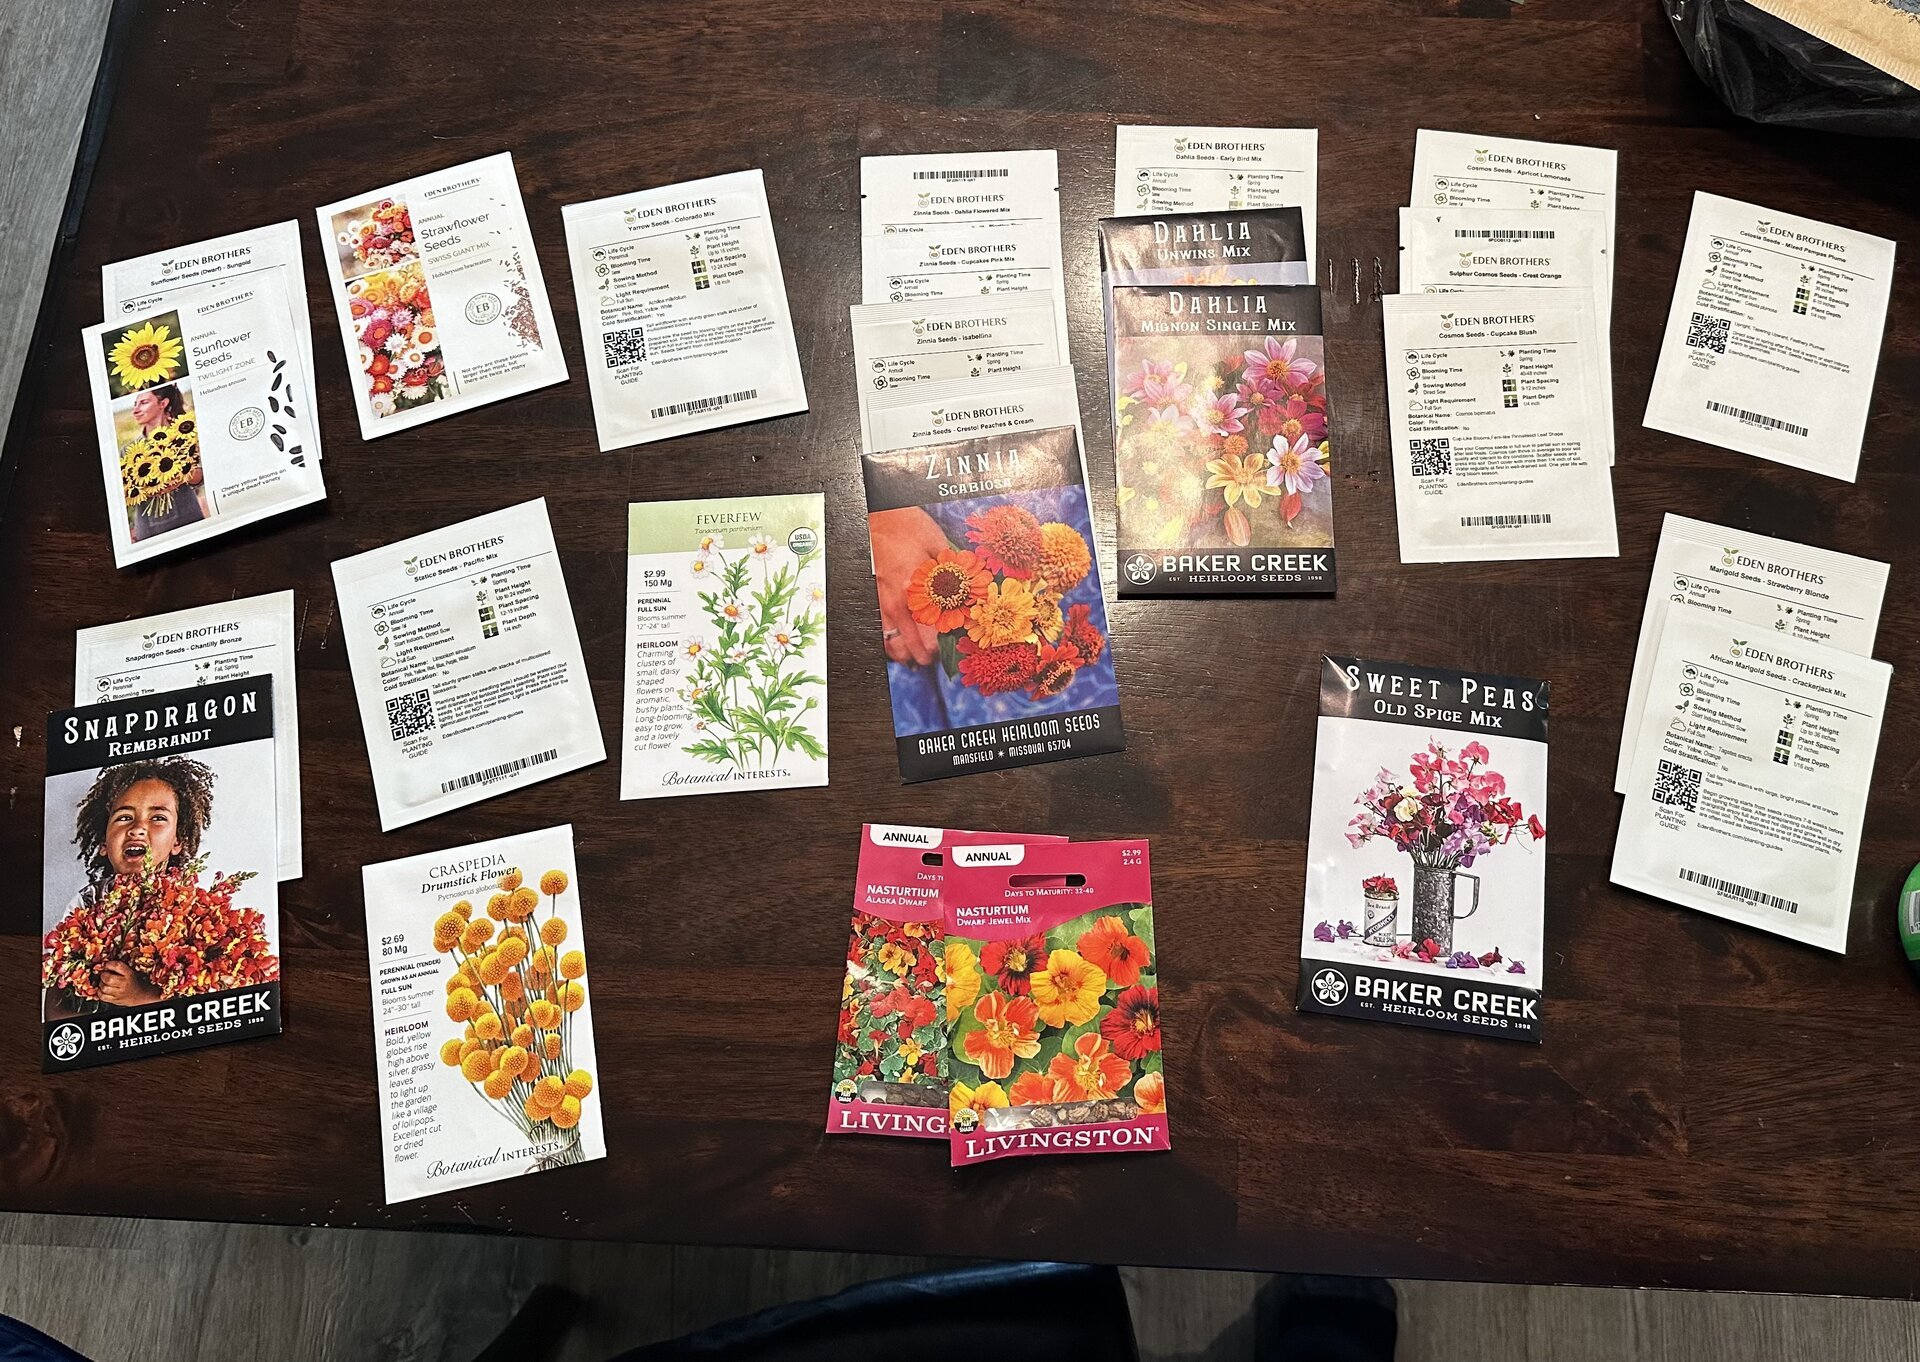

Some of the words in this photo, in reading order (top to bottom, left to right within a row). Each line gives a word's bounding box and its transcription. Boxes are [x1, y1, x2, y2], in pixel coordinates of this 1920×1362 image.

[1187, 142, 1213, 150] EDEN
[1214, 142, 1265, 152] BROTHERS
[1488, 154, 1514, 164] EDEN
[1515, 157, 1567, 171] BROTHERS
[637, 207, 663, 219] EDEN
[664, 197, 717, 214] BROTHERS
[930, 196, 955, 204] EDEN
[956, 194, 1004, 204] BROTHERS
[418, 213, 444, 225] ANNUAL
[420, 213, 490, 240] Strawflower
[1152, 221, 1251, 245] DAHLIA
[1769, 226, 1795, 239] EDEN
[1795, 233, 1845, 253] BROTHERS
[423, 235, 462, 253] Seeds
[427, 252, 453, 265] SWISS
[452, 244, 475, 258] GIANT
[476, 241, 491, 250] MIX
[941, 247, 966, 256] EDEN
[967, 243, 1017, 254] BROTHERS
[1156, 245, 1216, 262] UNWINS
[1221, 244, 1252, 259] MIX
[174, 259, 200, 271] EDEN
[201, 246, 251, 265] BROTHERS
[1472, 256, 1498, 265] EDEN
[1499, 256, 1551, 267] BROTHERS
[150, 275, 181, 287] Sunflower
[181, 271, 200, 280] Seeds
[200, 265, 222, 276] (Dwarf)
[226, 259, 252, 270] Sungold
[1168, 291, 1268, 315] DAHLIA
[926, 321, 953, 332] EDEN
[954, 317, 1007, 330] BROTHERS
[1140, 318, 1200, 333] MIGNON
[1206, 318, 1261, 332] SINGLE
[1267, 318, 1297, 331] MIX
[1454, 317, 1480, 327] EDEN
[1482, 314, 1535, 325] BROTHERS
[190, 330, 217, 343] ANNUAL
[916, 337, 937, 345] Zinnia
[937, 335, 958, 343] Seeds
[1490, 330, 1518, 338] Cupcake
[192, 331, 252, 357] Sunflower
[194, 351, 233, 370] Seeds
[197, 364, 233, 382] TWILIGHT
[234, 357, 256, 370] ZONE
[945, 411, 971, 422] EDEN
[972, 405, 1024, 419] BROTHERS
[932, 428, 952, 436] Seeds
[980, 421, 1007, 430] Peaches
[1013, 418, 1035, 426] Cream
[924, 448, 1021, 481] ZINNIA
[697, 511, 762, 525] FEVERFEW
[419, 553, 447, 569] EDEN
[448, 535, 504, 560] BROTHERS
[413, 571, 437, 583] Statice
[437, 565, 459, 576] Seeds
[462, 557, 485, 568] Pacific
[485, 553, 498, 561] Mix
[1161, 553, 1241, 573] BAKER
[1251, 554, 1328, 572] CREEK
[1736, 555, 1765, 571] EDEN
[1766, 563, 1826, 585] BROTHERS
[643, 569, 666, 579] $2.99
[644, 579, 659, 588] 150
[660, 578, 673, 588] Mg
[1188, 574, 1257, 583] HEIRLOOM
[1261, 574, 1302, 582] SEEDS
[1709, 564, 1740, 578] Marigold
[1739, 572, 1762, 583] Seeds
[1766, 579, 1804, 595] Strawberry
[1804, 588, 1830, 601] Blonde
[637, 597, 672, 605] PERENNIAL
[156, 632, 183, 645] EDEN
[185, 621, 239, 640] BROTHERS
[125, 651, 165, 663] Snapdragon
[165, 647, 186, 656] Seeds
[190, 640, 218, 651] Chantilly
[219, 636, 243, 645] Bronze
[636, 640, 679, 649] HEIRLOOM
[636, 650, 674, 659] Charming
[1744, 647, 1774, 664] EDEN
[1775, 656, 1835, 681] BROTHERS
[1709, 653, 1734, 666] African
[1734, 661, 1765, 675] Marigold
[1765, 670, 1787, 682] Seeds
[1792, 677, 1833, 695] Crackerjack
[1833, 689, 1847, 698] Mix
[1346, 665, 1441, 700] SWEET
[1460, 677, 1534, 712] PEAS
[64, 691, 257, 744] SNAPDRAGON
[1373, 699, 1407, 716] OLD
[1413, 703, 1463, 723] SPICE
[1469, 710, 1503, 729] MIX
[108, 728, 212, 758] REMBRANDT
[918, 734, 956, 755] BAKER
[960, 728, 997, 749] CREEK
[1001, 719, 1060, 743] HEIRLOOM
[1064, 713, 1100, 733] SEEDS
[952, 749, 994, 766] MANSFIELD
[1008, 742, 1045, 758] MISSOURI
[1047, 738, 1072, 752] 65704
[661, 766, 734, 786] Botanical
[882, 832, 929, 844] ANNUAL
[965, 851, 1012, 862] ANNUAL
[1121, 849, 1142, 857] $2.99
[1123, 858, 1135, 866] 2.4
[1135, 857, 1142, 865] G
[429, 853, 506, 879] CRASPEDIA
[421, 872, 478, 894] Drumstick
[480, 866, 517, 881] Flower
[865, 895, 897, 905] ALASKA
[898, 896, 928, 907] DWARF
[866, 884, 939, 899] NASTURTIUM
[1004, 889, 1024, 898] DAYS
[1036, 886, 1074, 896] MATURITY:
[1073, 886, 1094, 895] 32-40
[956, 904, 1029, 917] NASTURTIUM
[956, 918, 986, 927] DWARF
[987, 917, 1014, 926] JEWEL
[1015, 915, 1032, 924] MIX
[381, 933, 405, 946] $2.69
[382, 946, 393, 957] 80
[394, 944, 408, 955] Mg
[1354, 975, 1443, 1007] BAKER
[1453, 989, 1538, 1020] CREEK
[90, 1008, 176, 1042] BAKER
[186, 990, 271, 1024] CREEK
[1382, 1003, 1458, 1022] HEIRLOOM
[1462, 1014, 1508, 1028] SEEDS
[119, 1027, 193, 1049] HEIRLOOM
[197, 1019, 242, 1035] SEEDS
[384, 1020, 429, 1037] HEIRLOOM
[385, 1035, 406, 1047] Bold,
[406, 1031, 432, 1045] yellow
[840, 1110, 947, 1134] LIVING
[965, 1126, 1155, 1158] LIVINGSTON
[426, 1146, 502, 1179] Botanical
